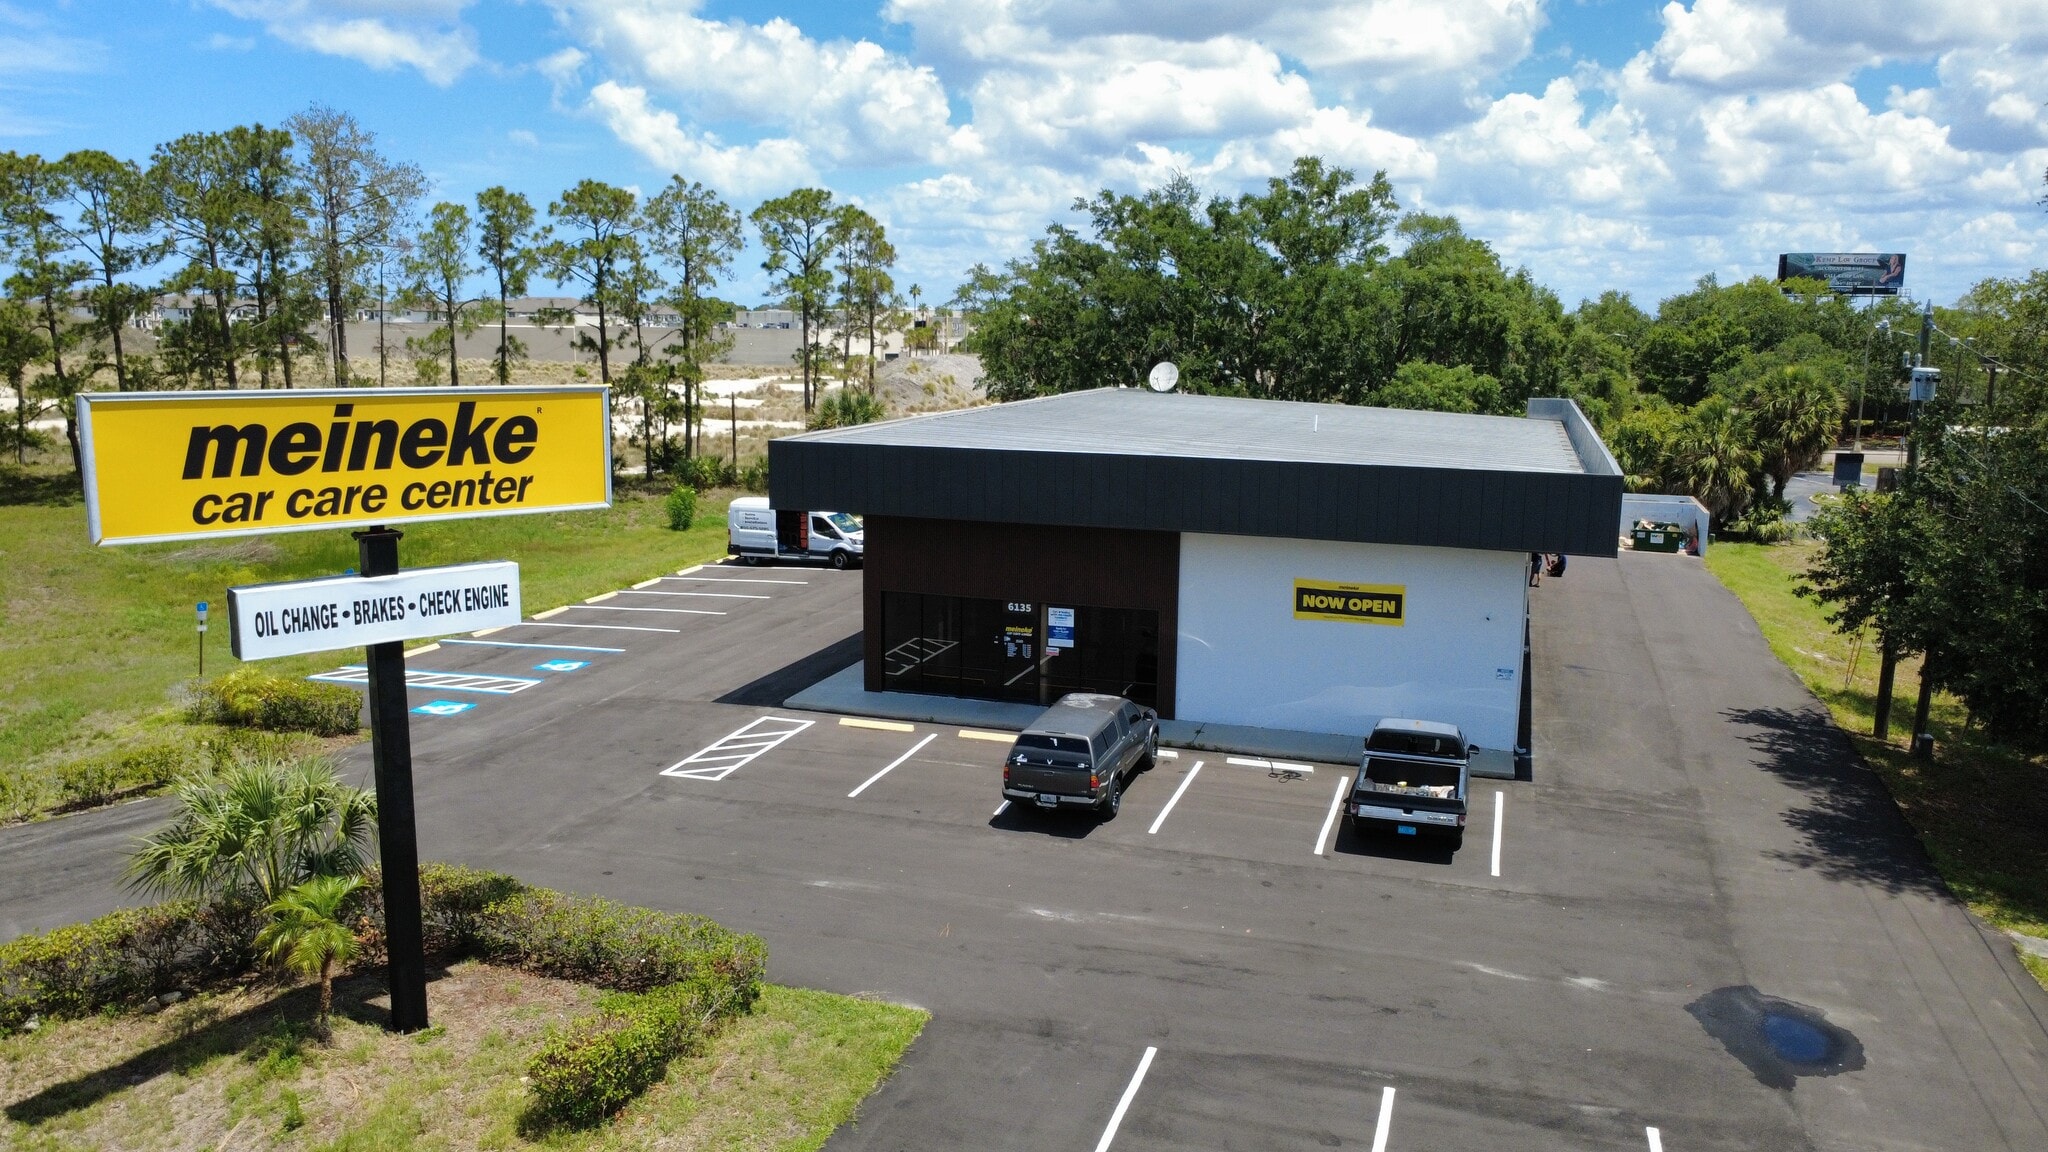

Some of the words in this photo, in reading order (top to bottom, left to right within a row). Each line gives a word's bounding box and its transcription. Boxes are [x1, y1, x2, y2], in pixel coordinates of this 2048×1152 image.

[182, 401, 537, 480] meineke
[193, 489, 274, 525] car
[286, 483, 388, 519] care
[401, 470, 534, 511] center
[255, 611, 279, 638] OIL
[281, 603, 339, 635] CHANGE
[353, 595, 405, 626] BRAKES
[419, 590, 462, 618] CHECK
[464, 583, 509, 612] ENGINE
[1007, 602, 1032, 613] 6135
[1302, 594, 1346, 611] NOW
[1348, 598, 1396, 614] OPEN
